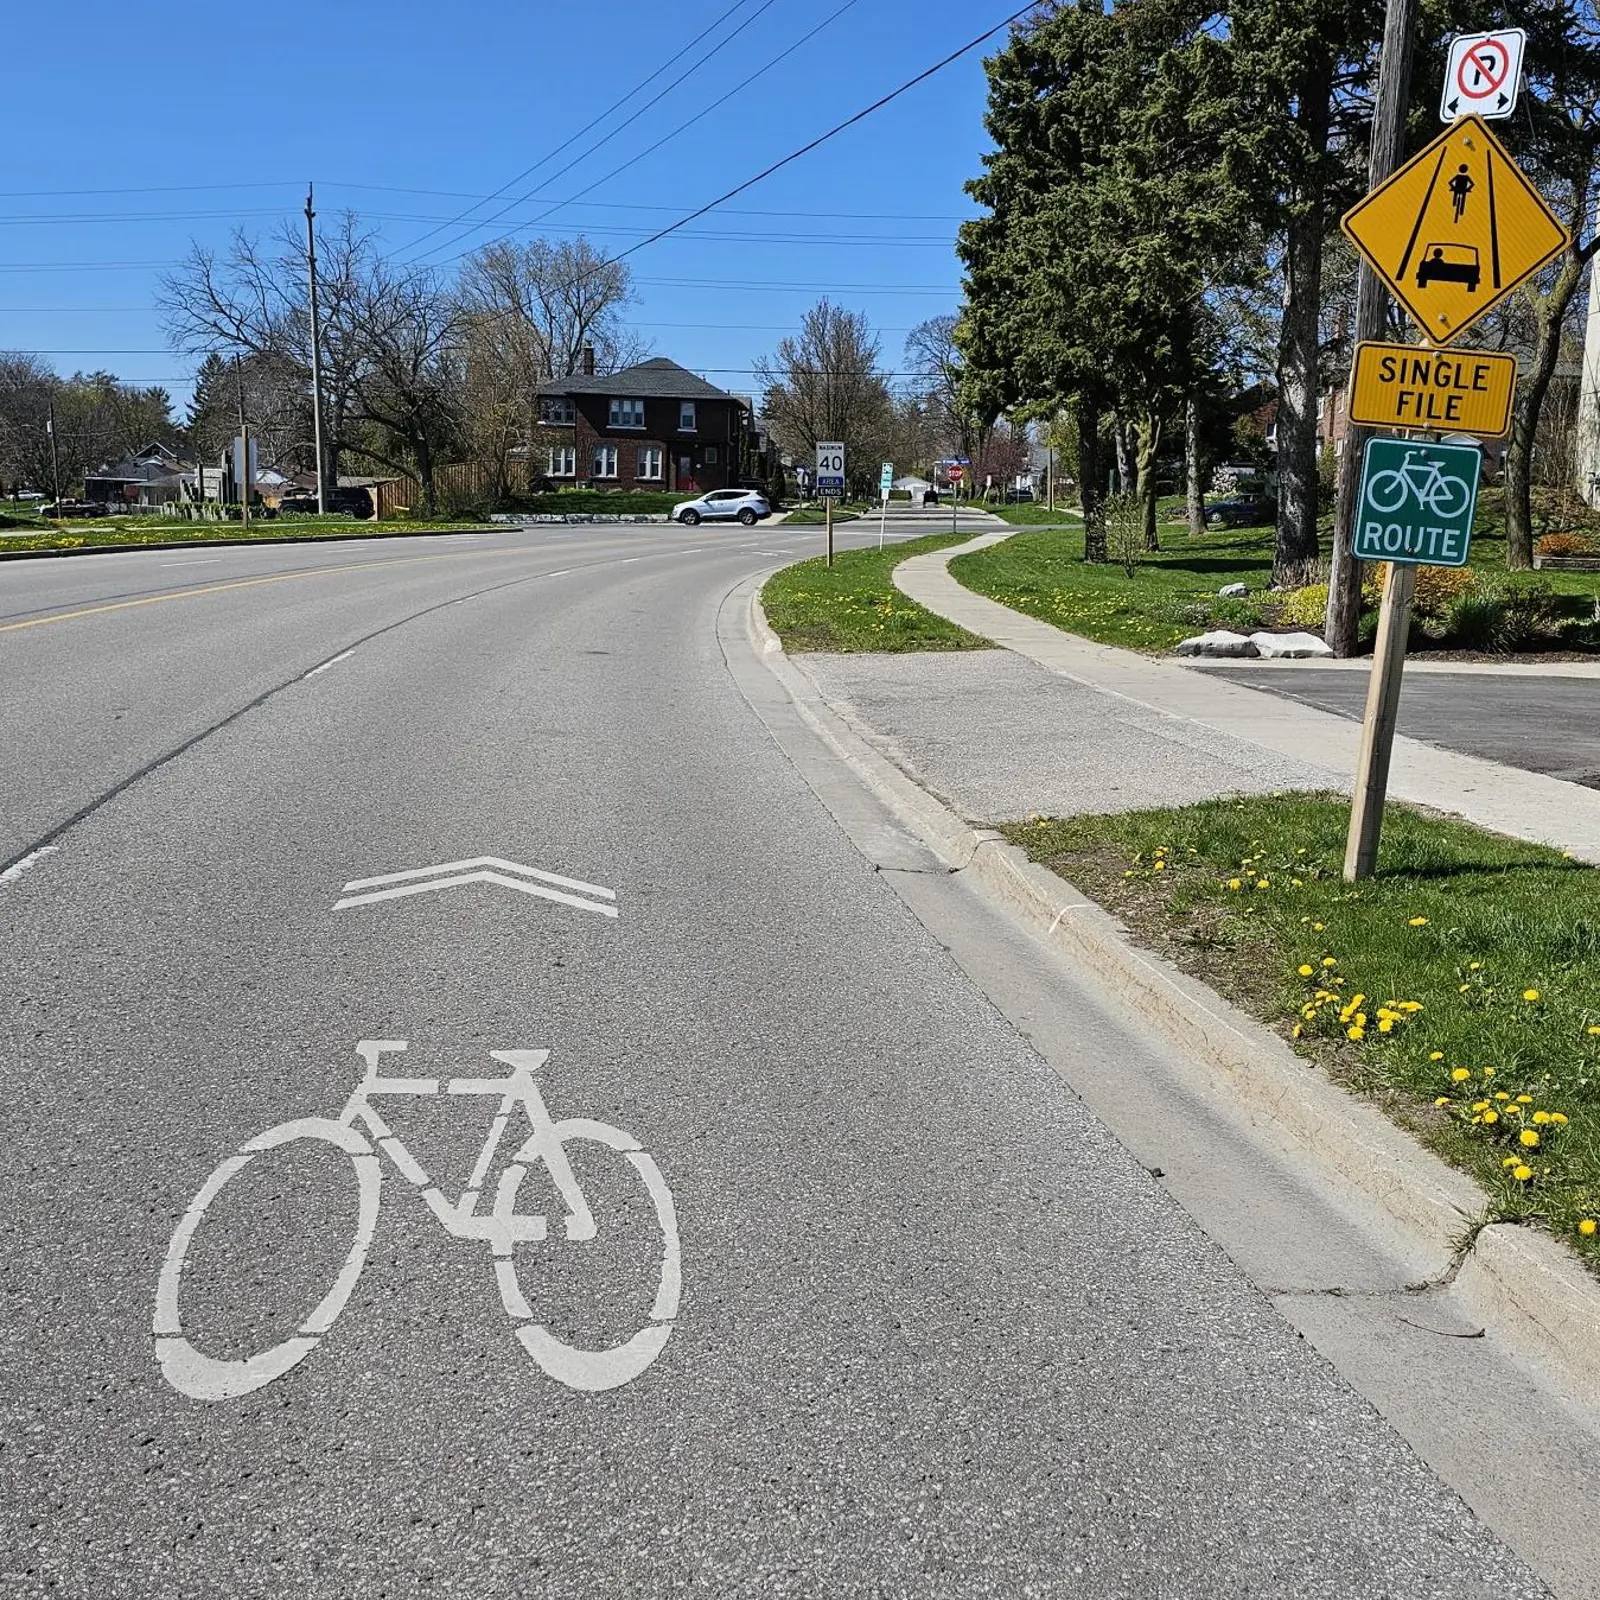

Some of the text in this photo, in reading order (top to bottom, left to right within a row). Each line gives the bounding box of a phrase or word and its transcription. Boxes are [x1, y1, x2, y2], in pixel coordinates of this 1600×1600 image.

[1379, 356, 1490, 391] SINGLE
[1396, 390, 1463, 421] FILE
[819, 455, 842, 471] 40
[820, 488, 842, 496] ENDS
[822, 478, 841, 486] AREA
[1363, 522, 1461, 557] ROUTE
